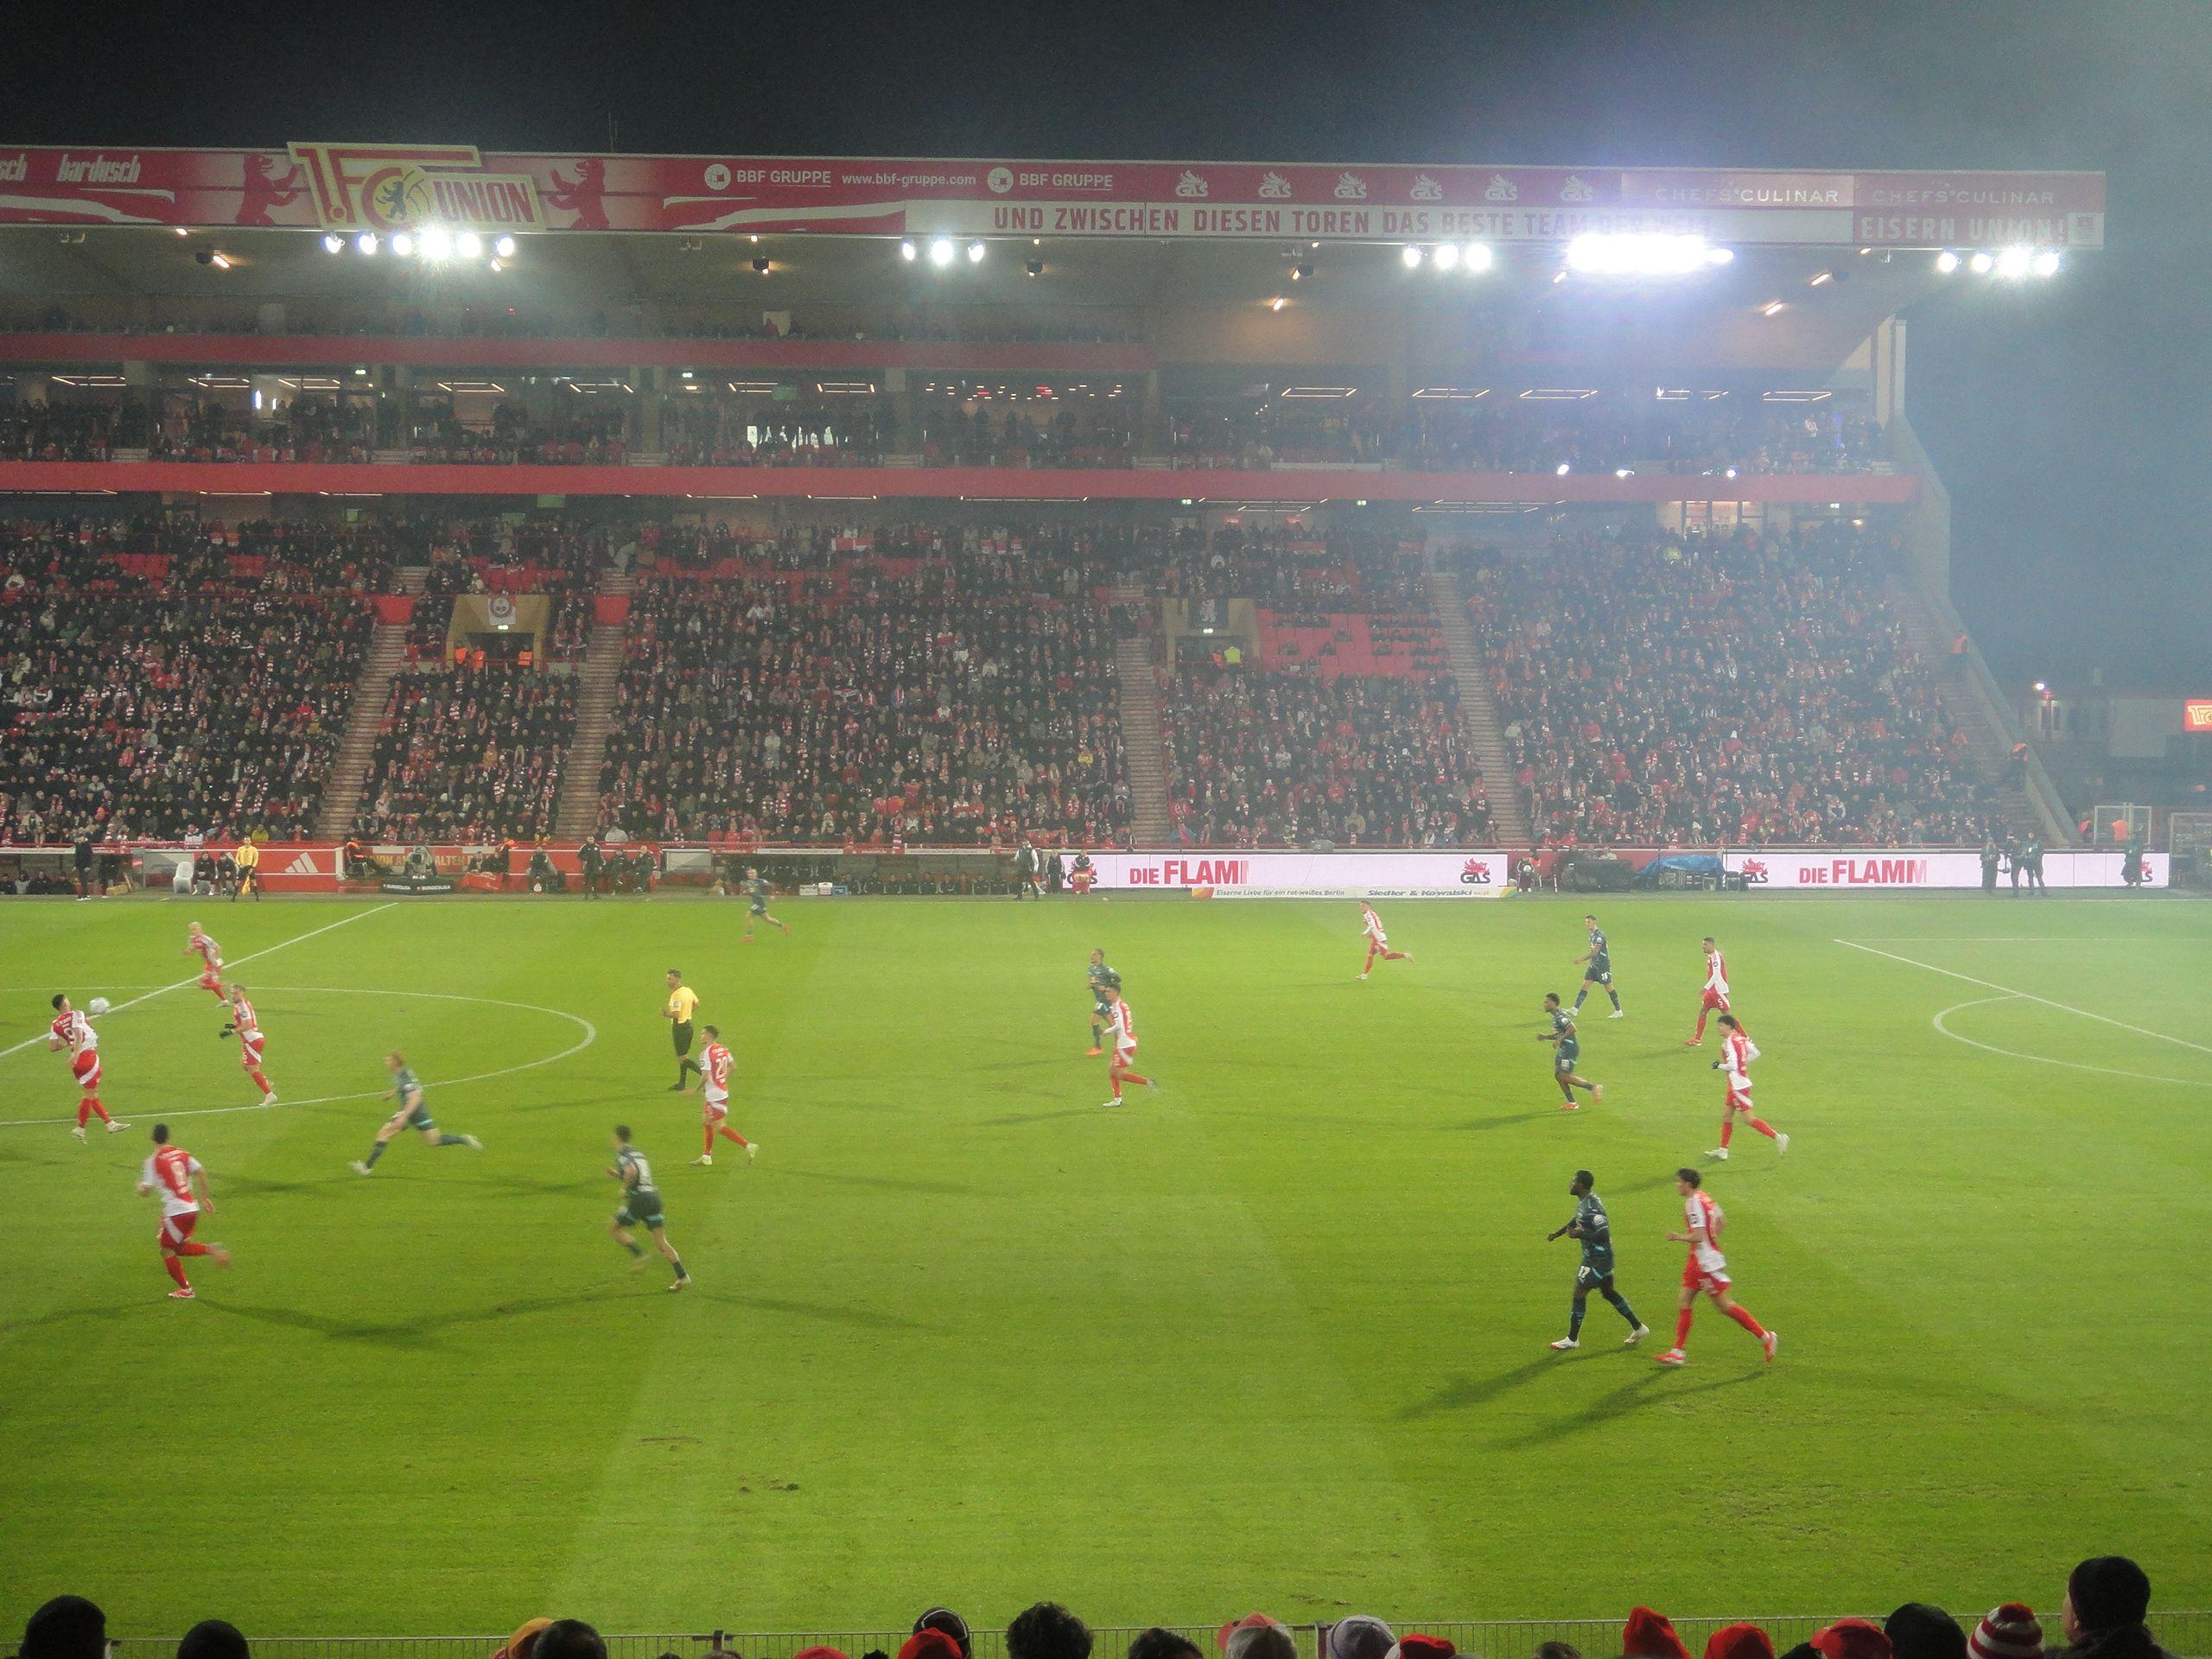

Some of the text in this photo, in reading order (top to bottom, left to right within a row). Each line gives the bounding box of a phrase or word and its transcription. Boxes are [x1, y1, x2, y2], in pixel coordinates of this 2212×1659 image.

[737, 169, 976, 187] BBF GRUPPE www.bbf-gruppe.com
[1020, 173, 1113, 187] BBF GRUPPE
[432, 180, 536, 223] UNION
[1740, 189, 1839, 203] CULINAR
[1955, 191, 2054, 204] CULINAR
[995, 207, 1043, 230] UND
[1055, 207, 1179, 231] ZWISCHEN
[1194, 209, 1280, 232] DIESEN
[1292, 210, 1369, 233] TOREN
[1383, 212, 1428, 233] DAS
[1441, 213, 1513, 235] BESTE
[1524, 213, 1589, 236] TEAM
[1861, 216, 2064, 241] EISERN UNION!
[1129, 868, 1160, 885] DIE
[1799, 860, 1928, 884] DIE FLAMM
